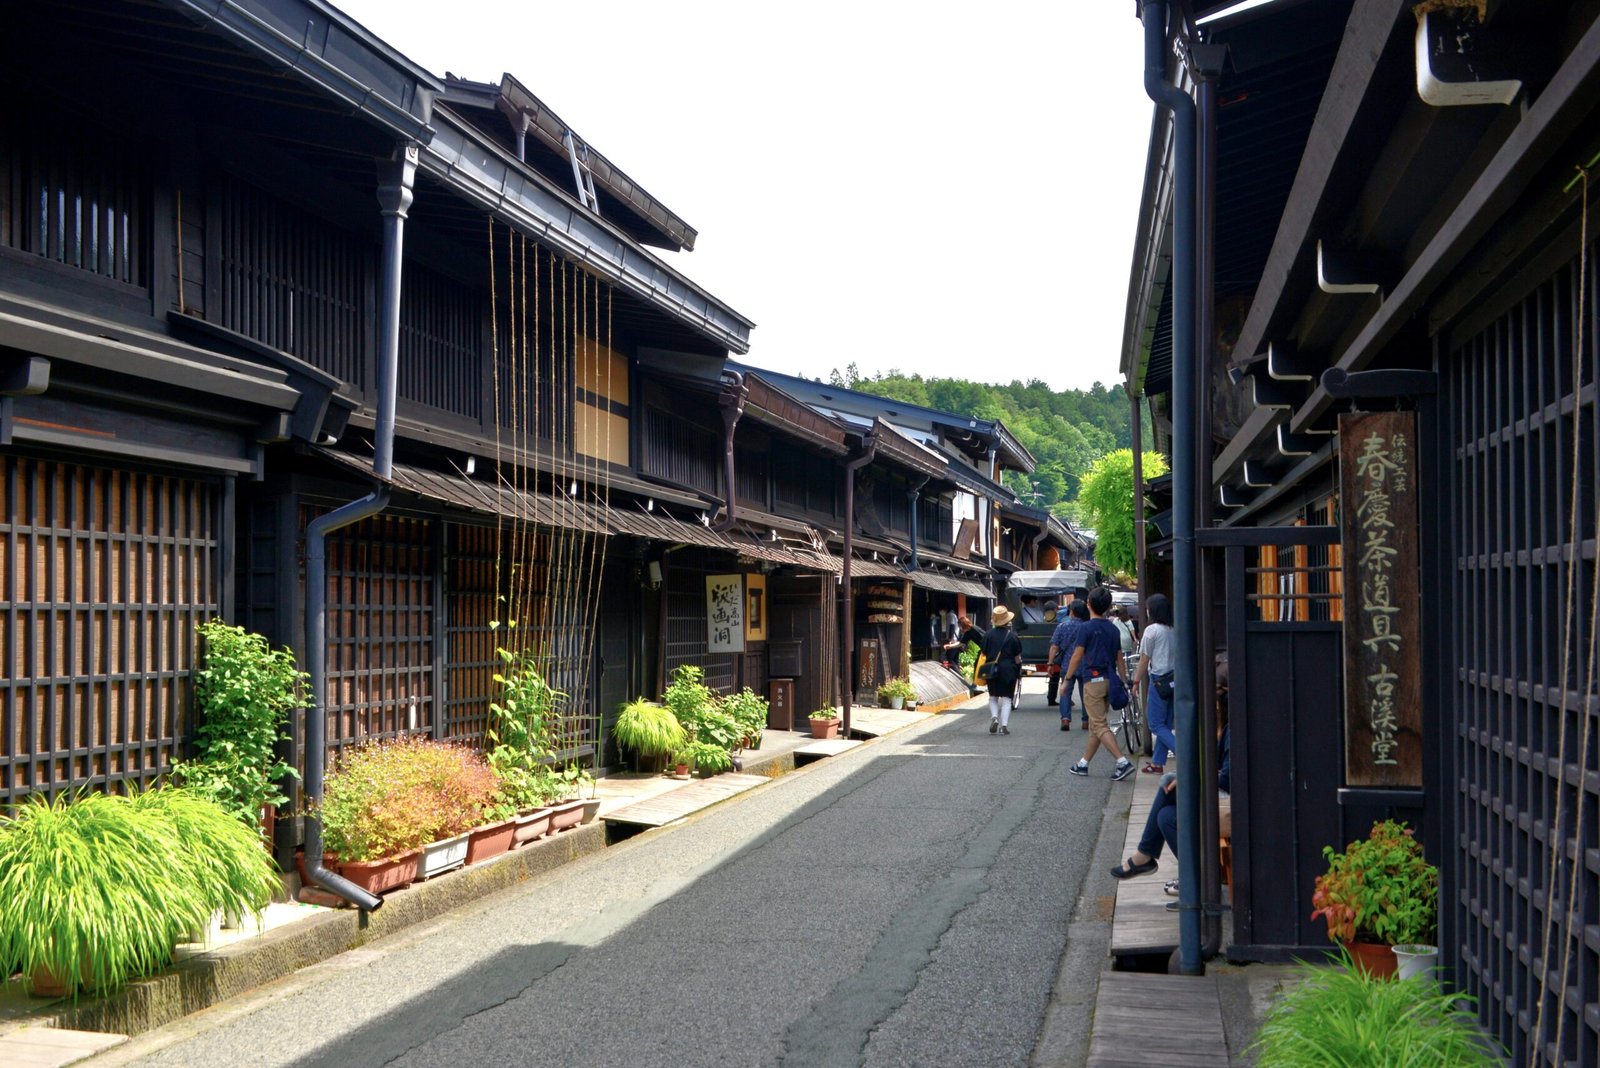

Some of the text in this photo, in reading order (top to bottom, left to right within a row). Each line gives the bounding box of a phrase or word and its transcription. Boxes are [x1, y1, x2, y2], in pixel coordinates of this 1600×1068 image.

[1391, 433, 1408, 492] 伝統工芸
[1357, 431, 1402, 652] 春慶茶道具
[712, 584, 731, 645] 版画洞
[729, 584, 739, 627] ひだ高山
